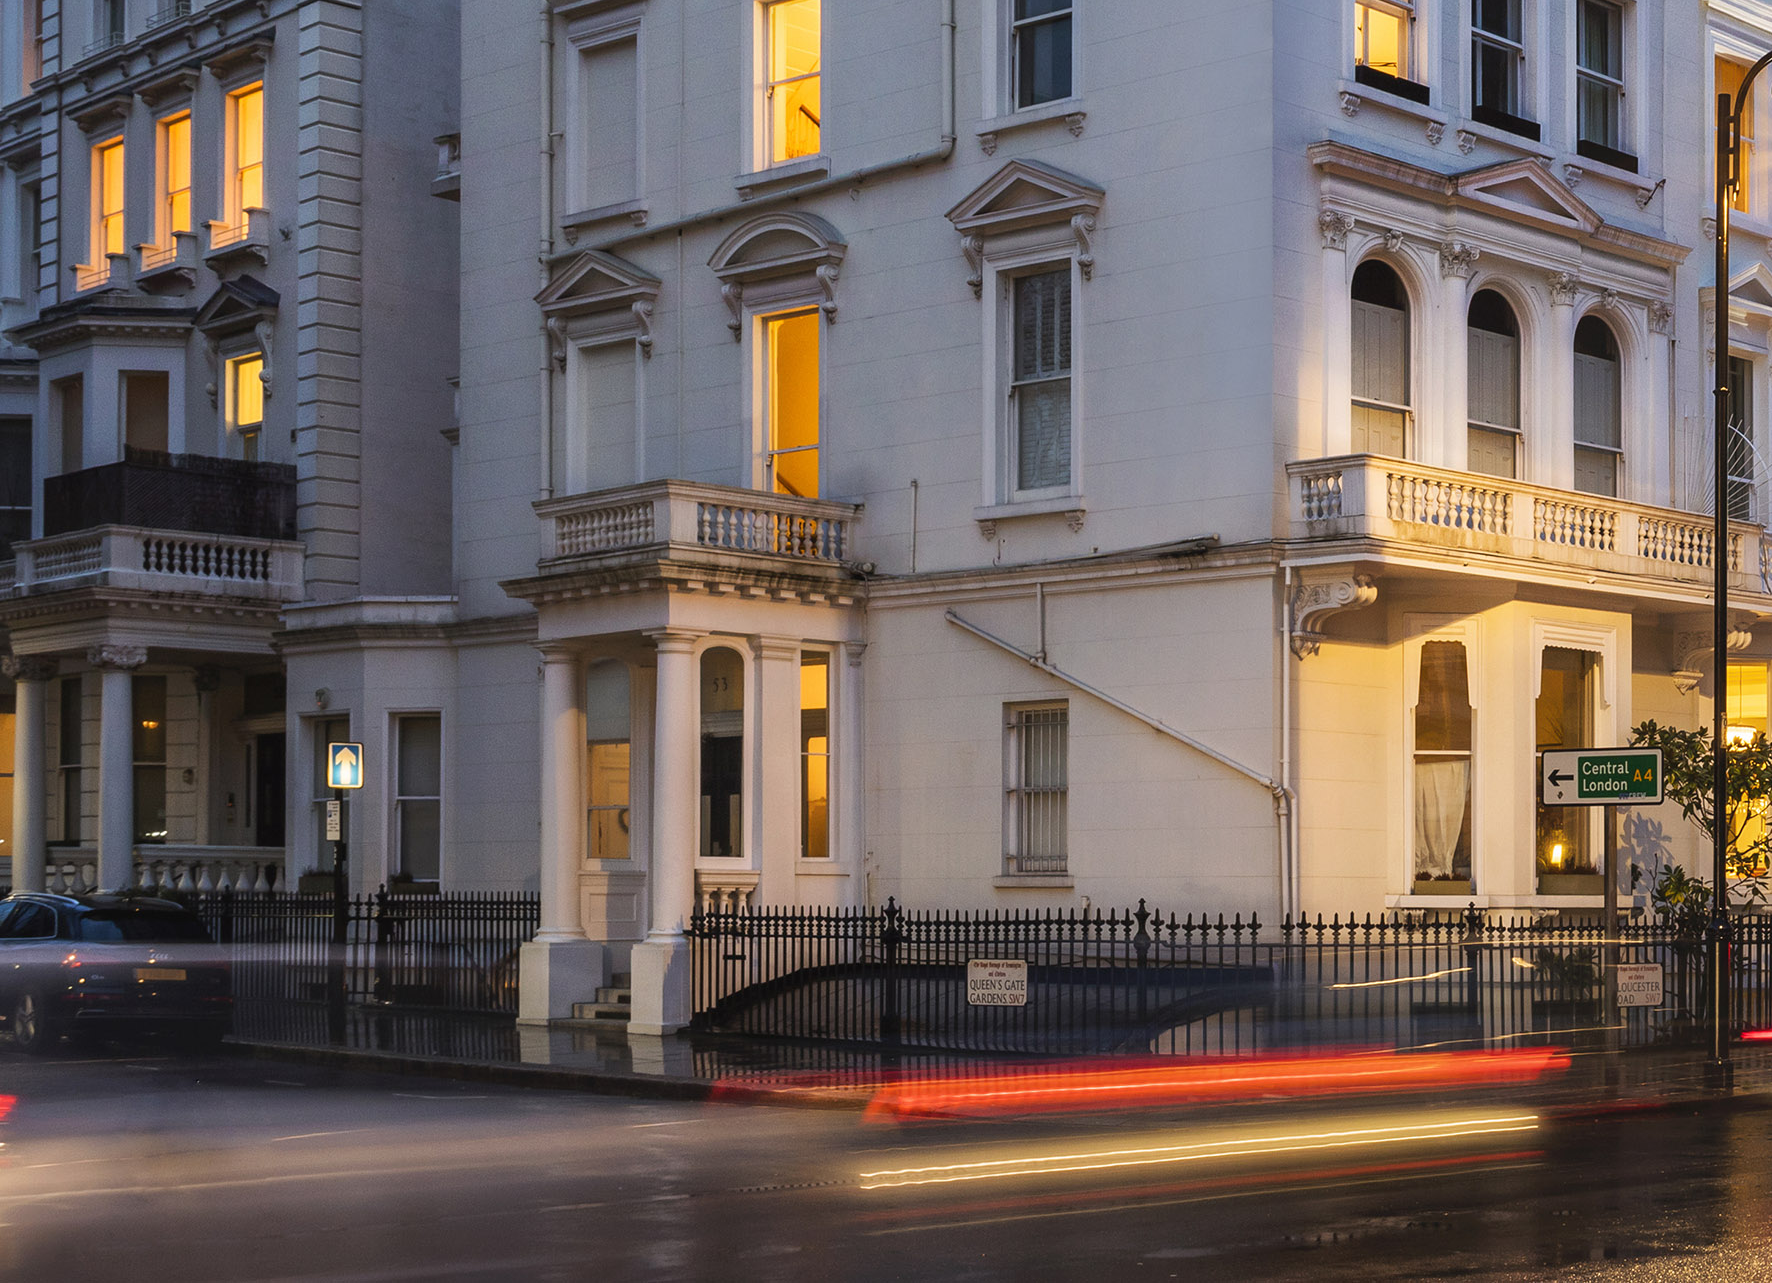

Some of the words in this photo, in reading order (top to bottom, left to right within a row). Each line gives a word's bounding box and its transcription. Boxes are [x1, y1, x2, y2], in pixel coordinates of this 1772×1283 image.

[713, 677, 728, 694] 53
[1582, 761, 1629, 775] Central
[1633, 768, 1653, 782] A4
[1583, 778, 1628, 792] London
[970, 979, 1002, 991] QUEEN'S
[1004, 980, 1025, 991] GATE
[1617, 981, 1661, 992] LOUCESTER
